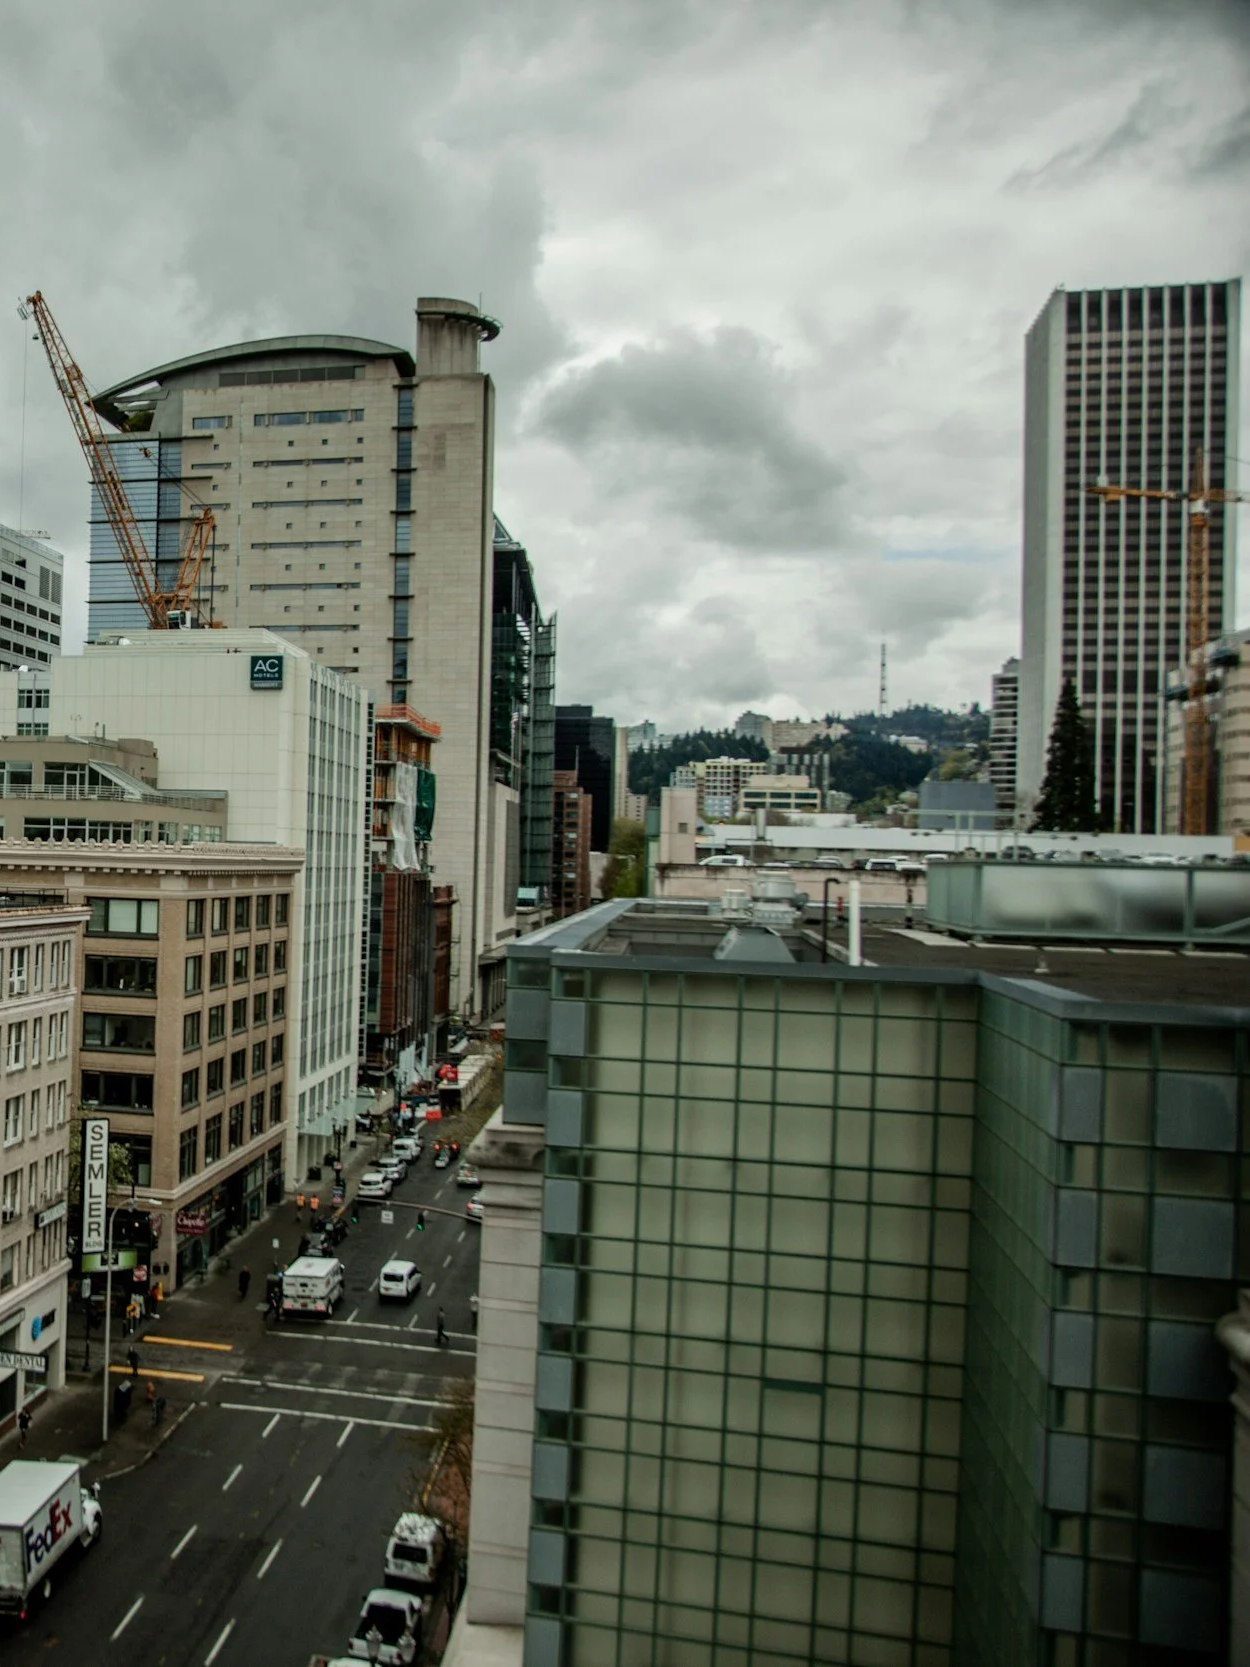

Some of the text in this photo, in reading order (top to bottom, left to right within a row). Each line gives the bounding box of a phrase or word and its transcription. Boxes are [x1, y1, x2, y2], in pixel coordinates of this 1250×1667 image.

[253, 659, 279, 673] AC
[88, 1124, 104, 1238] SEMLER
[14, 1353, 45, 1368] DENTAL
[25, 1498, 72, 1574] FedEx
